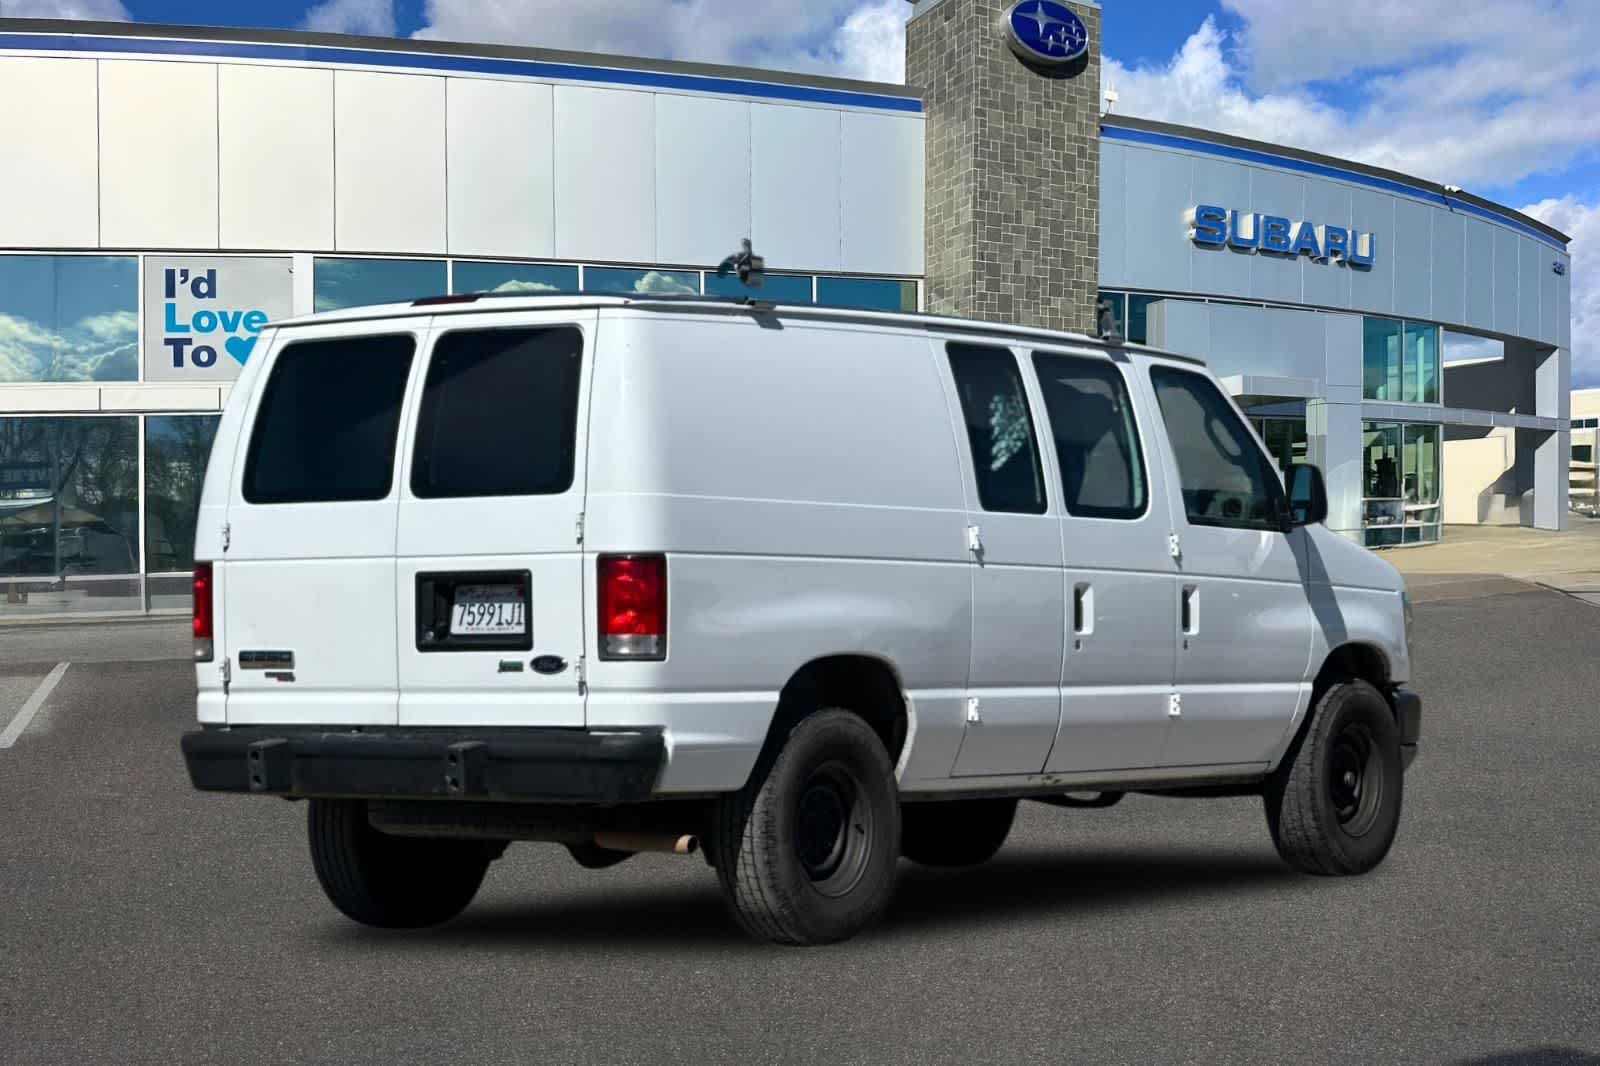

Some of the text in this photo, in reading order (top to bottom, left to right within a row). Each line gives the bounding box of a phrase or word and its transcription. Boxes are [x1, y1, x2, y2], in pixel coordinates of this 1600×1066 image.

[1192, 204, 1376, 270] SUBARU
[164, 268, 217, 299] I’d
[164, 302, 269, 333] Love
[163, 337, 218, 368] To
[457, 602, 524, 627] 75991J1
